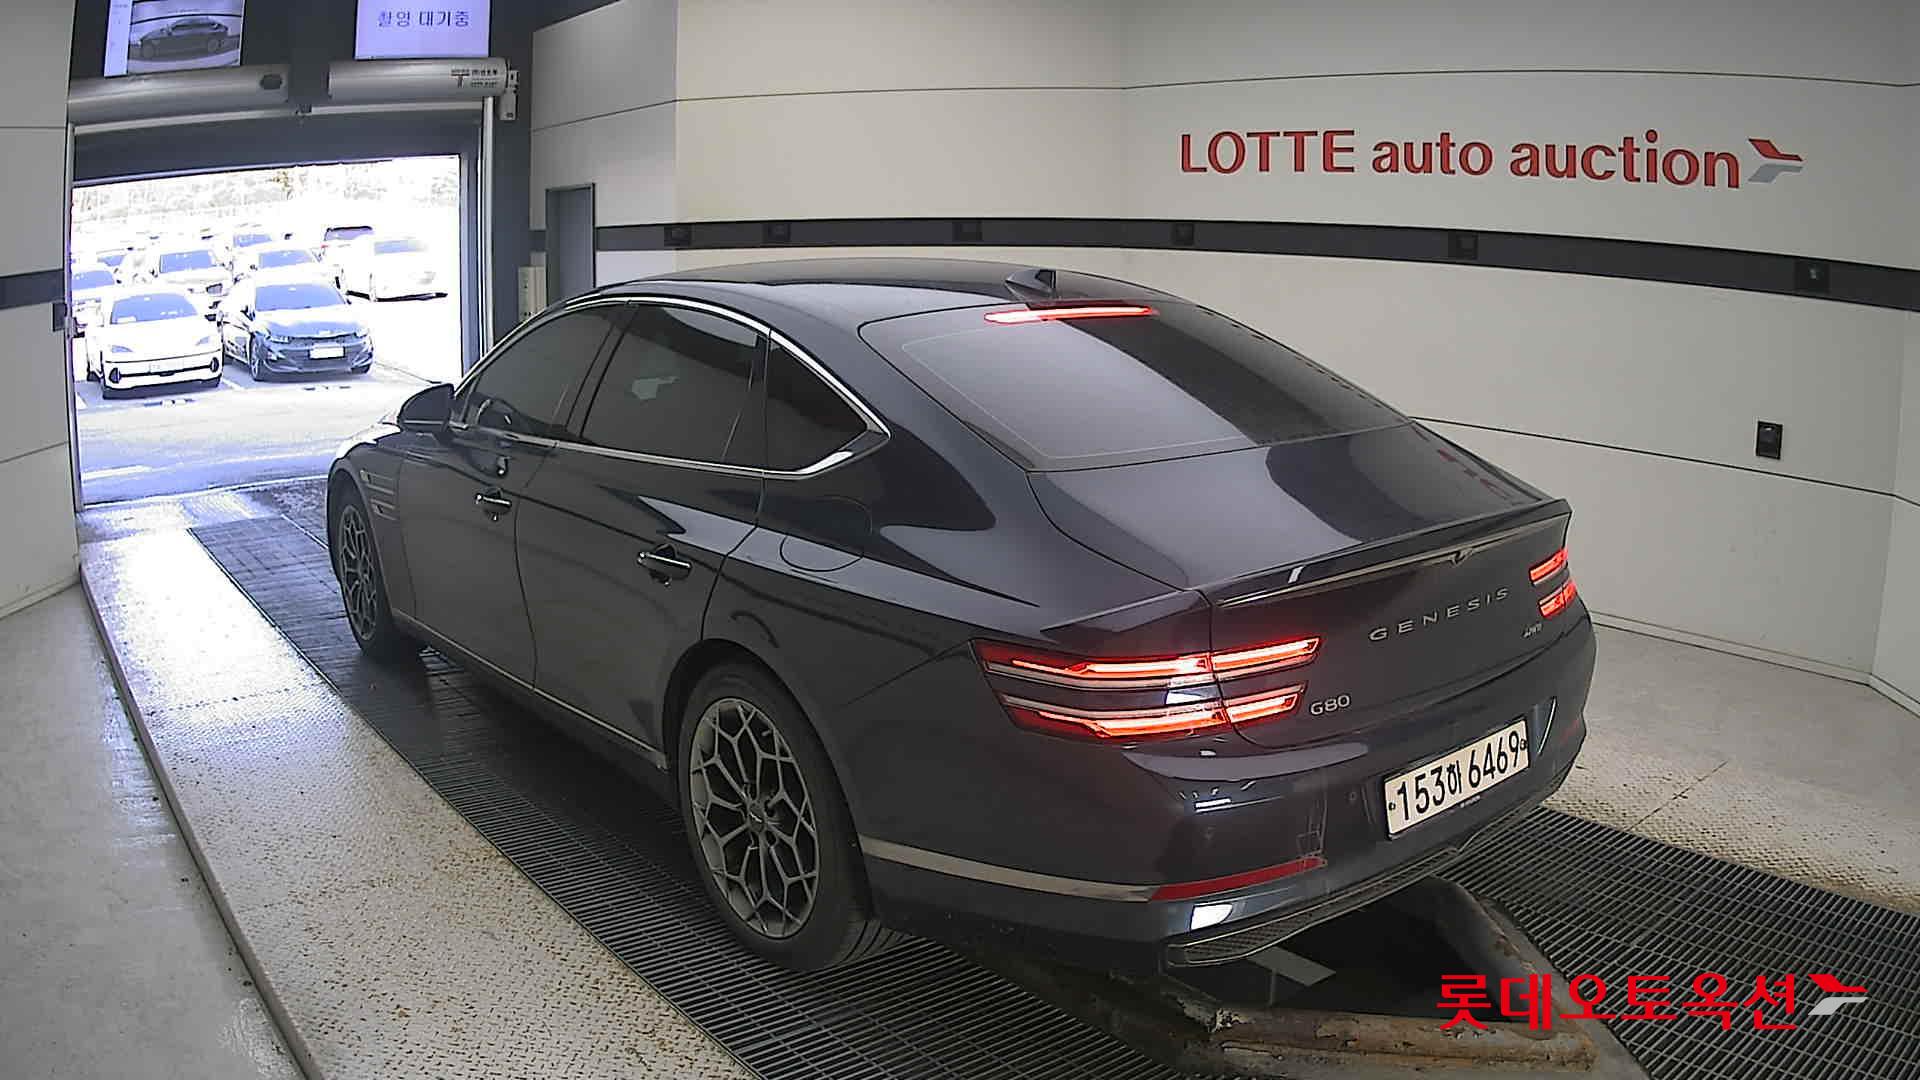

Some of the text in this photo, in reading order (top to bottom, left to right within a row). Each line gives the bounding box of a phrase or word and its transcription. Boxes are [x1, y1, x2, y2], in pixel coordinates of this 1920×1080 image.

[419, 11, 470, 27] 대기중
[1181, 129, 1739, 188] LOTTE auto auction
[1369, 588, 1508, 641] GENESIS
[1310, 694, 1351, 715] G80
[1468, 730, 1520, 788] 6469
